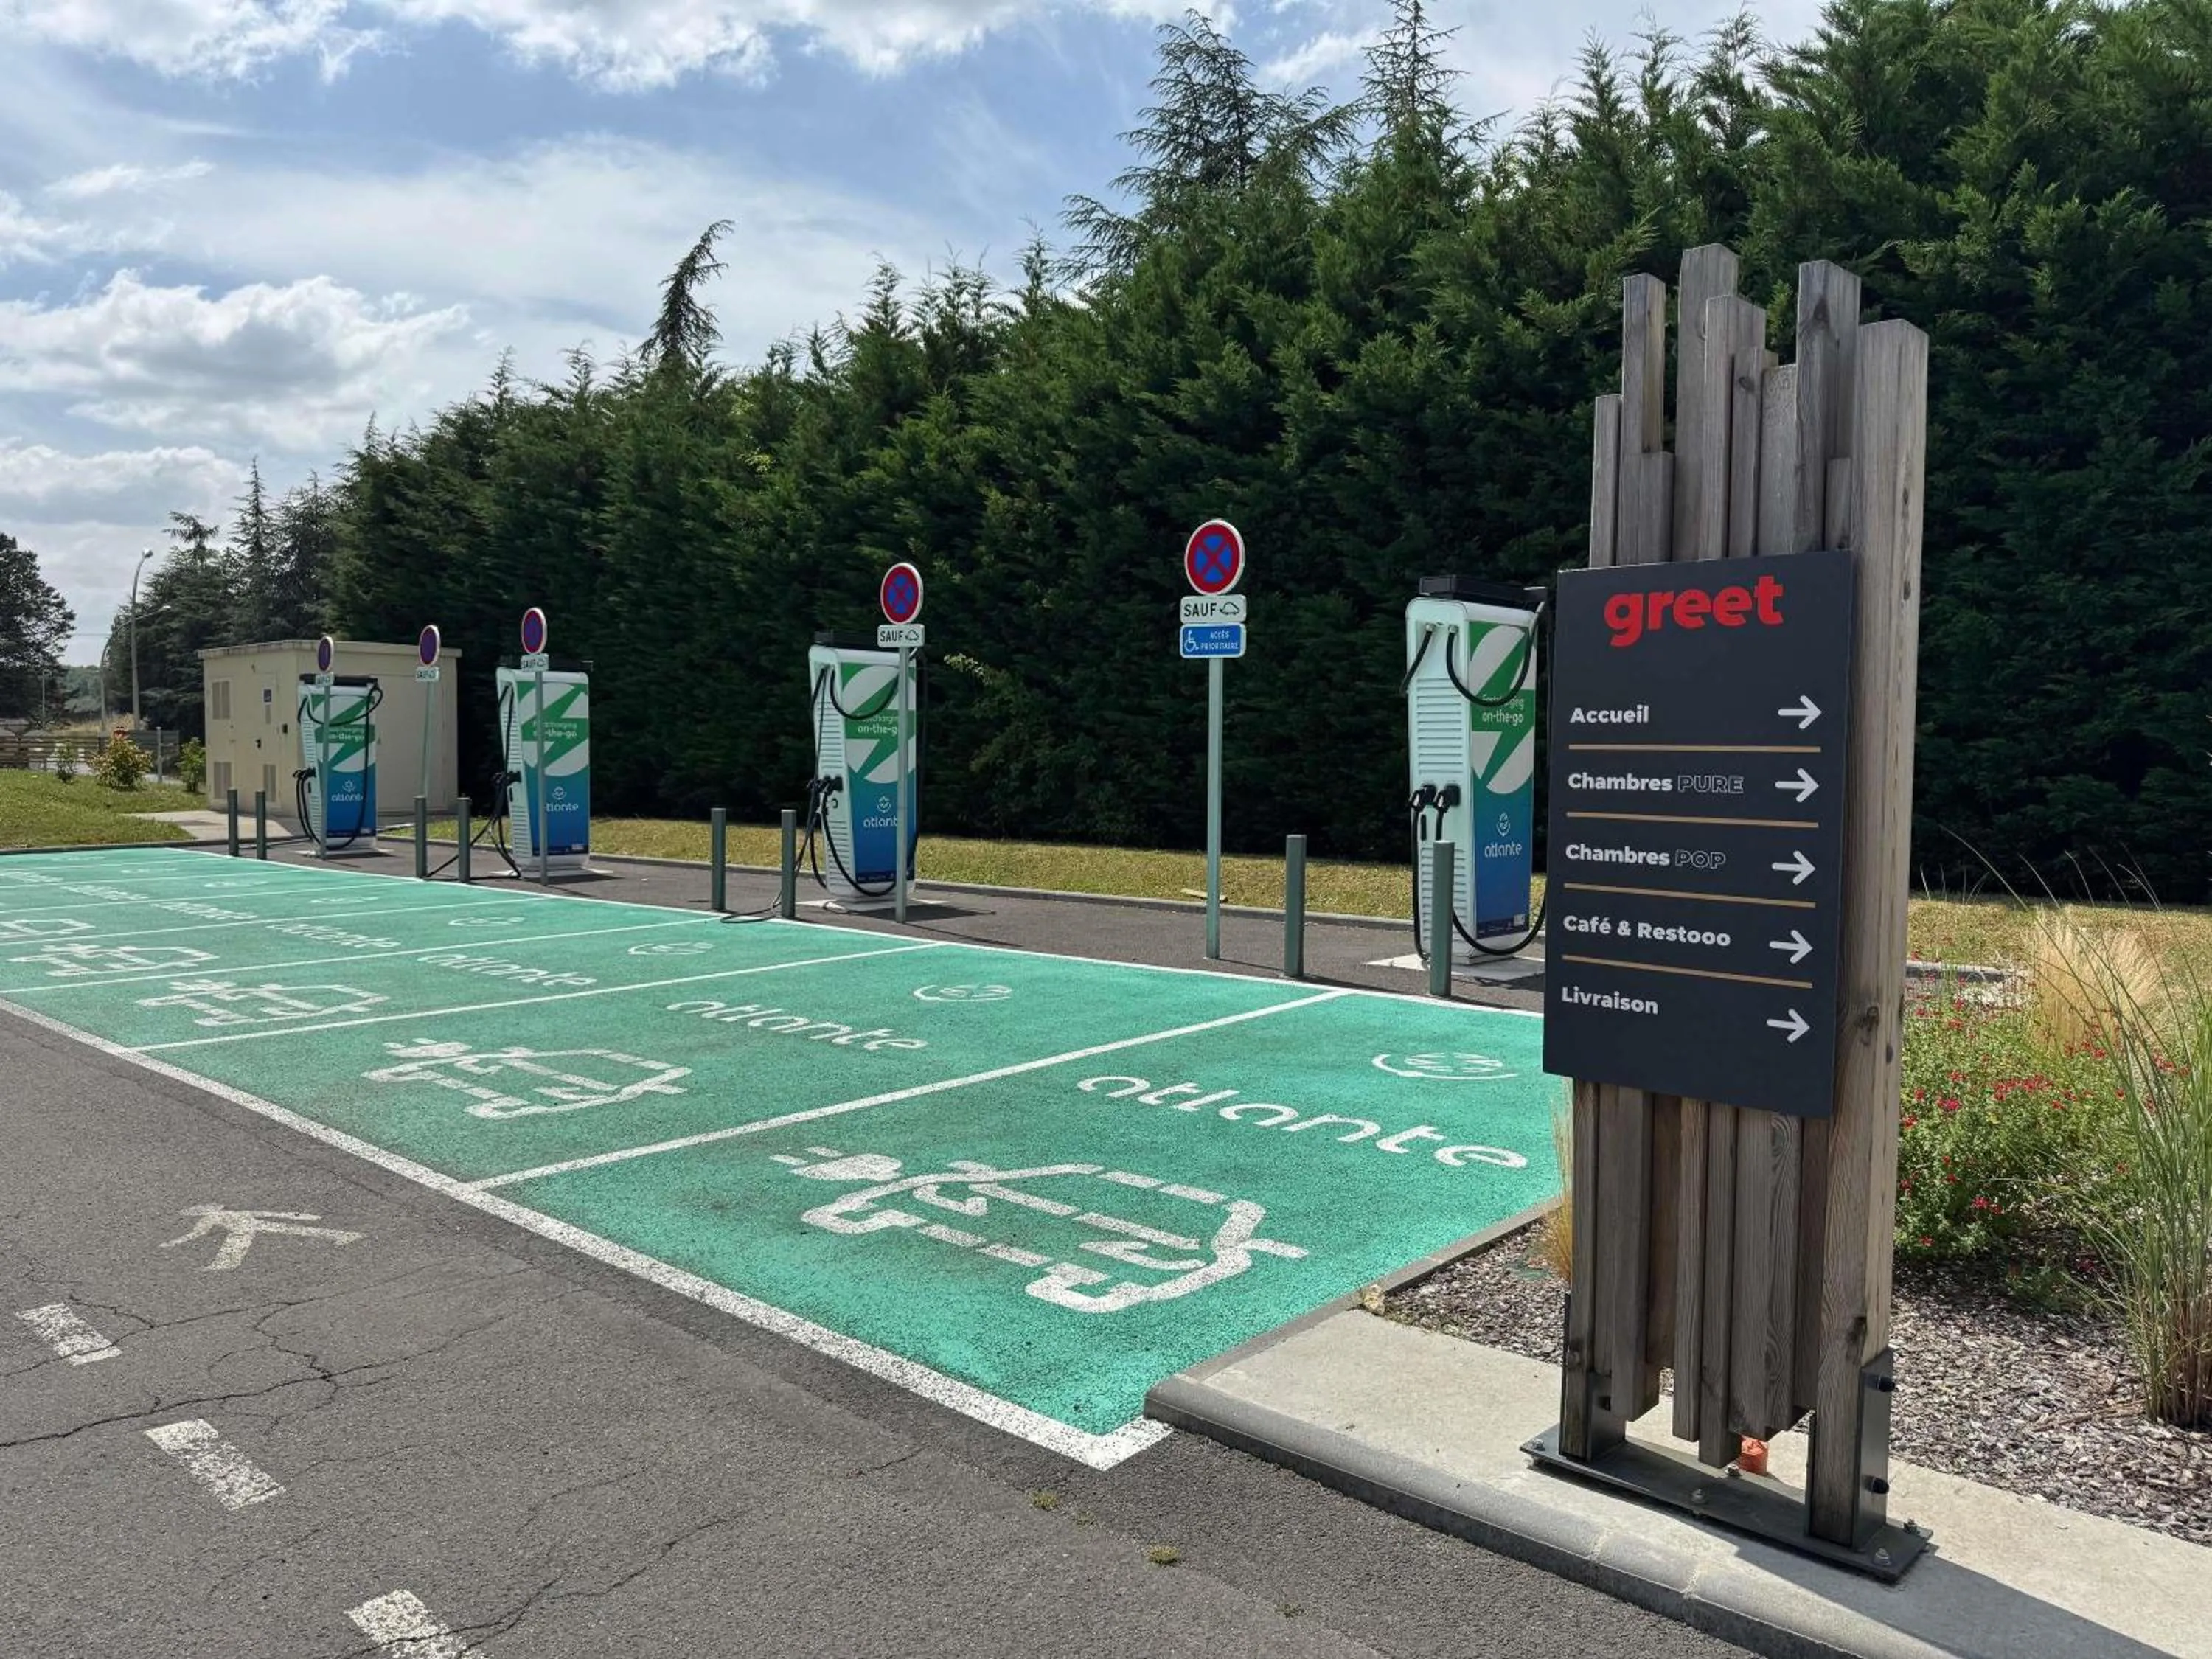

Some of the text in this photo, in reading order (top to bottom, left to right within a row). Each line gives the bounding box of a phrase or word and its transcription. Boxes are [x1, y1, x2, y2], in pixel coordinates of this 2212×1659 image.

[1183, 602, 1217, 617] SAUF
[1604, 575, 1784, 647] greet
[880, 630, 903, 642] SAUF
[1482, 709, 1524, 726] on-the-go
[1570, 705, 1649, 723] Accueil
[858, 724, 898, 734] on-the-g
[1568, 773, 1744, 794] Chambres PURE
[863, 815, 897, 827] atlant
[1484, 841, 1523, 858] atlante
[1565, 844, 1726, 869] Chambres POP
[1563, 915, 1731, 946] Café & Restooo
[1562, 986, 1658, 1015] Livraison
[1077, 1075, 1528, 1169] atlante
